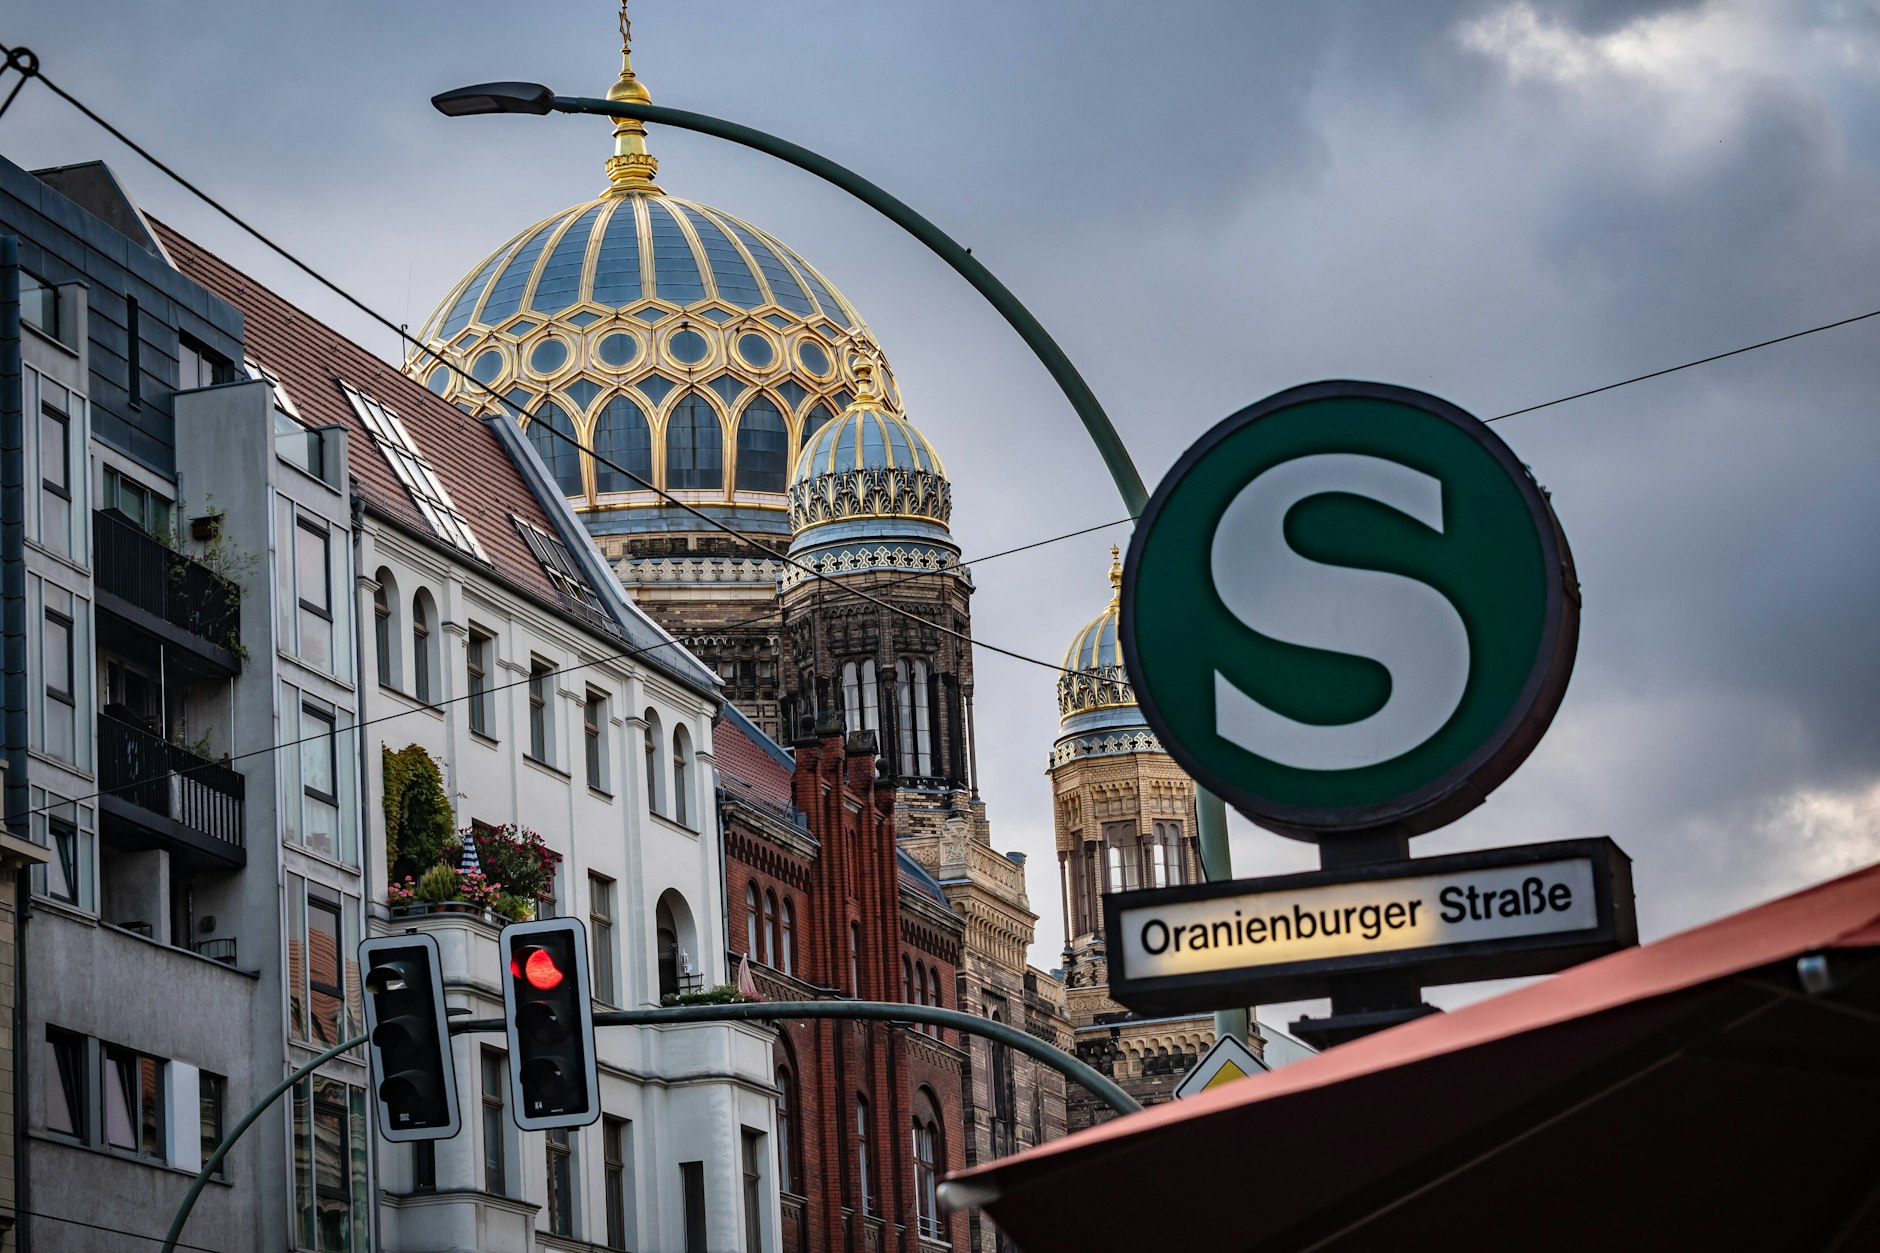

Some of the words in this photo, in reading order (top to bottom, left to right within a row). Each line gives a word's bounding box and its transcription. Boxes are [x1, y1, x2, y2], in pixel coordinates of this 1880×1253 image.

[1210, 452, 1471, 771] S
[1140, 899, 1422, 955] Oranienburger
[1439, 877, 1572, 923] Straße
